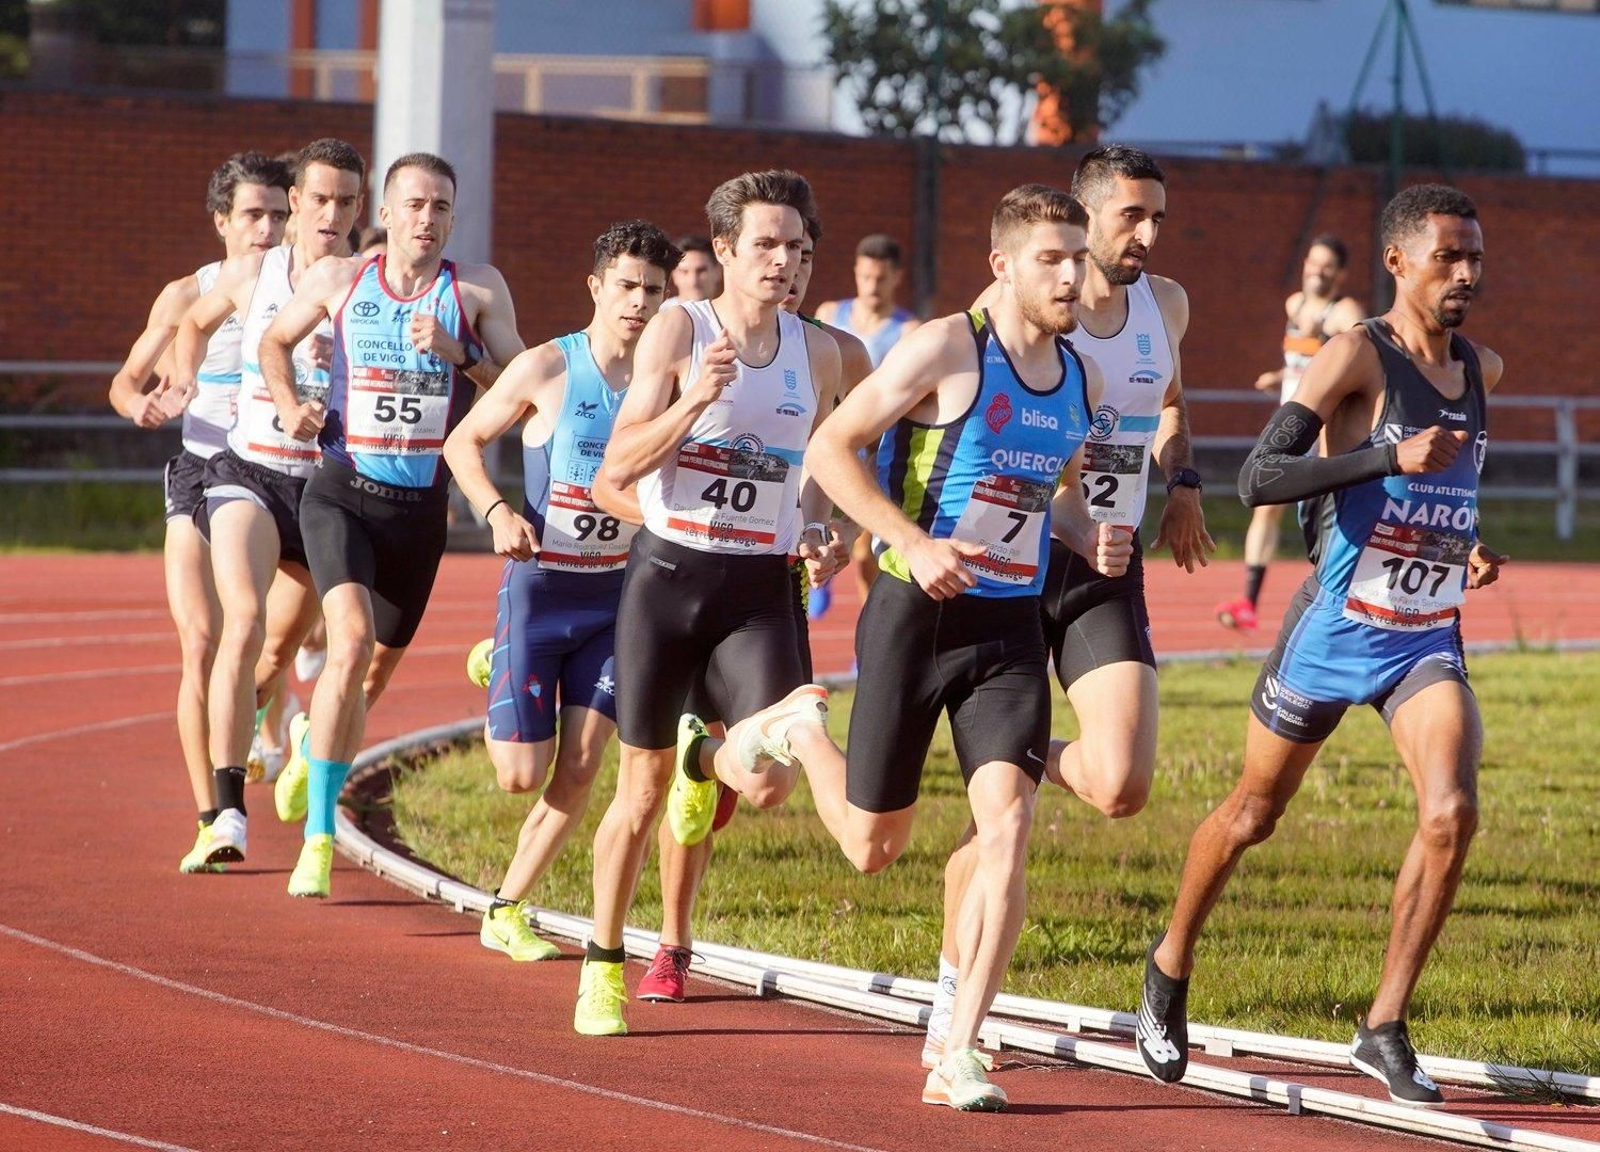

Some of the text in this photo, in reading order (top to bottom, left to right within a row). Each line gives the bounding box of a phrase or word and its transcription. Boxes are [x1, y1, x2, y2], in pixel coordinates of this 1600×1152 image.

[357, 339, 413, 352] CONCELLO
[363, 352, 406, 364] DE VIGO
[374, 395, 422, 424] 55
[383, 433, 405, 442] VIGO
[701, 478, 757, 513] 40
[1408, 482, 1434, 494] CLUB
[721, 513, 748, 523] Fuente
[573, 514, 621, 542] 98
[709, 520, 734, 533] VIGO
[1001, 511, 1028, 543] 7
[684, 527, 757, 548] terreo de xogo
[580, 551, 602, 560] VIGO
[988, 551, 1011, 566] VIGO
[1382, 557, 1451, 597] 107
[1365, 610, 1397, 626] terreo
[1394, 605, 1419, 618] VIGO
[1280, 687, 1313, 705] DEPORTE
[1280, 692, 1310, 709] GALEGO
